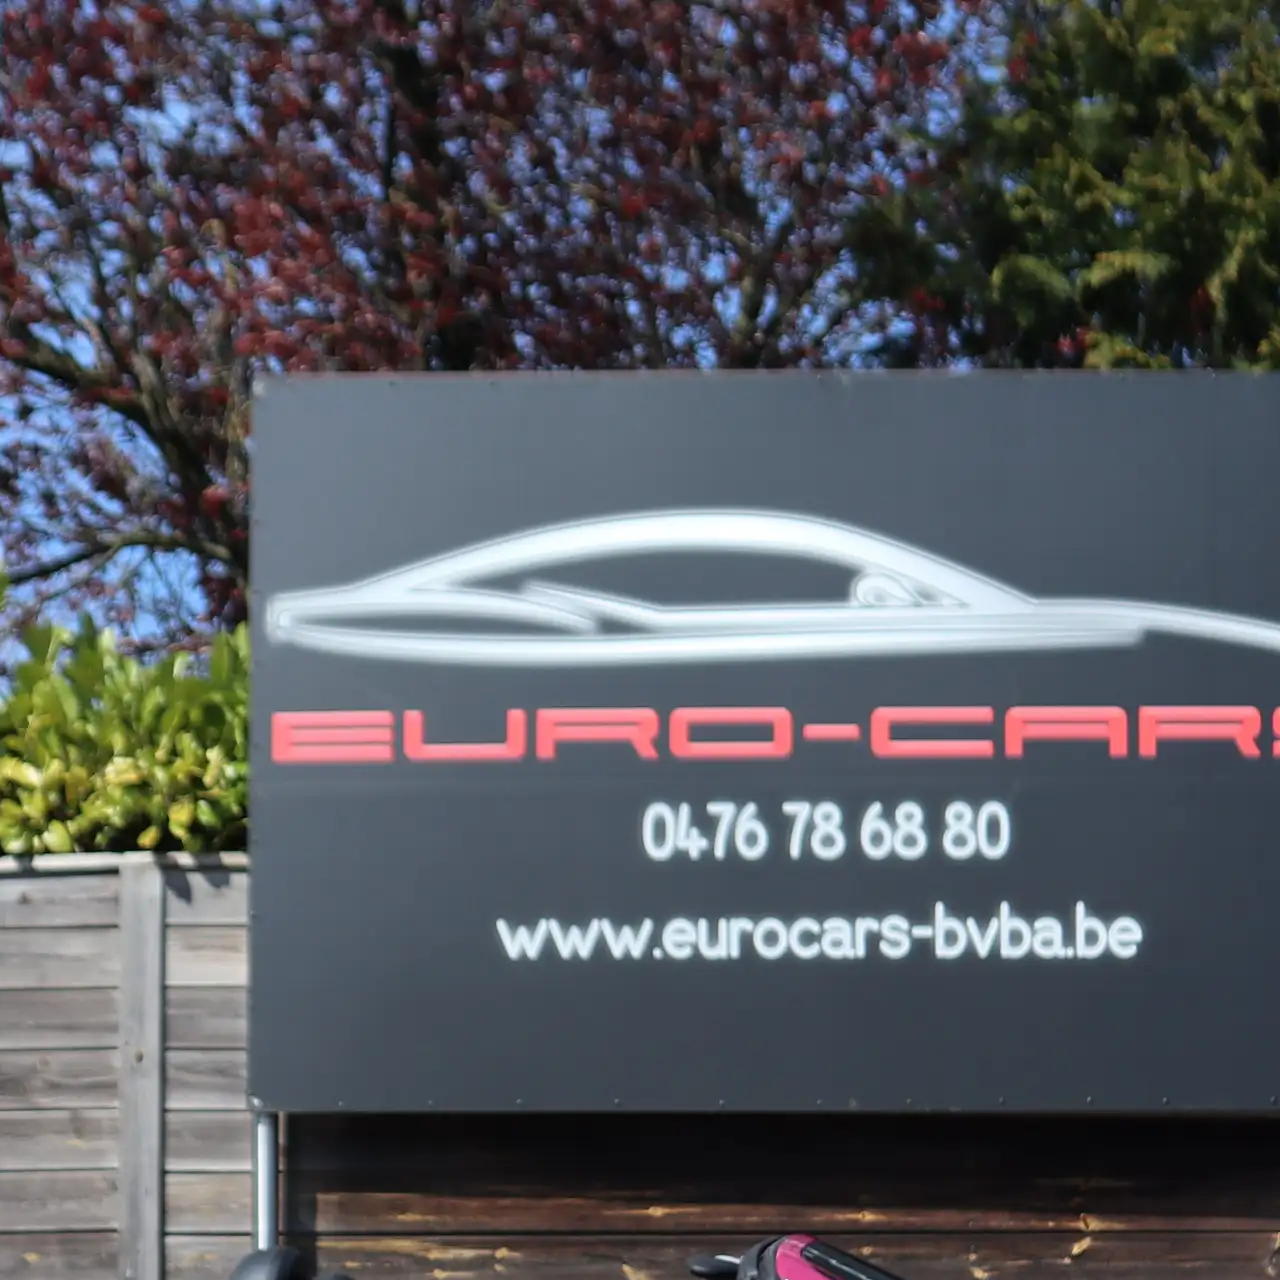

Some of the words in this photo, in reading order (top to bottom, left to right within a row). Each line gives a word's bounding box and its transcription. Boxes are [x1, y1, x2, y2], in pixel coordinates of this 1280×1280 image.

[641, 800, 769, 862] 0476
[781, 800, 846, 861] 78
[859, 800, 928, 861] 68
[942, 800, 1012, 861] 80
[495, 900, 1144, 962] www.eurocars-bvba.be
